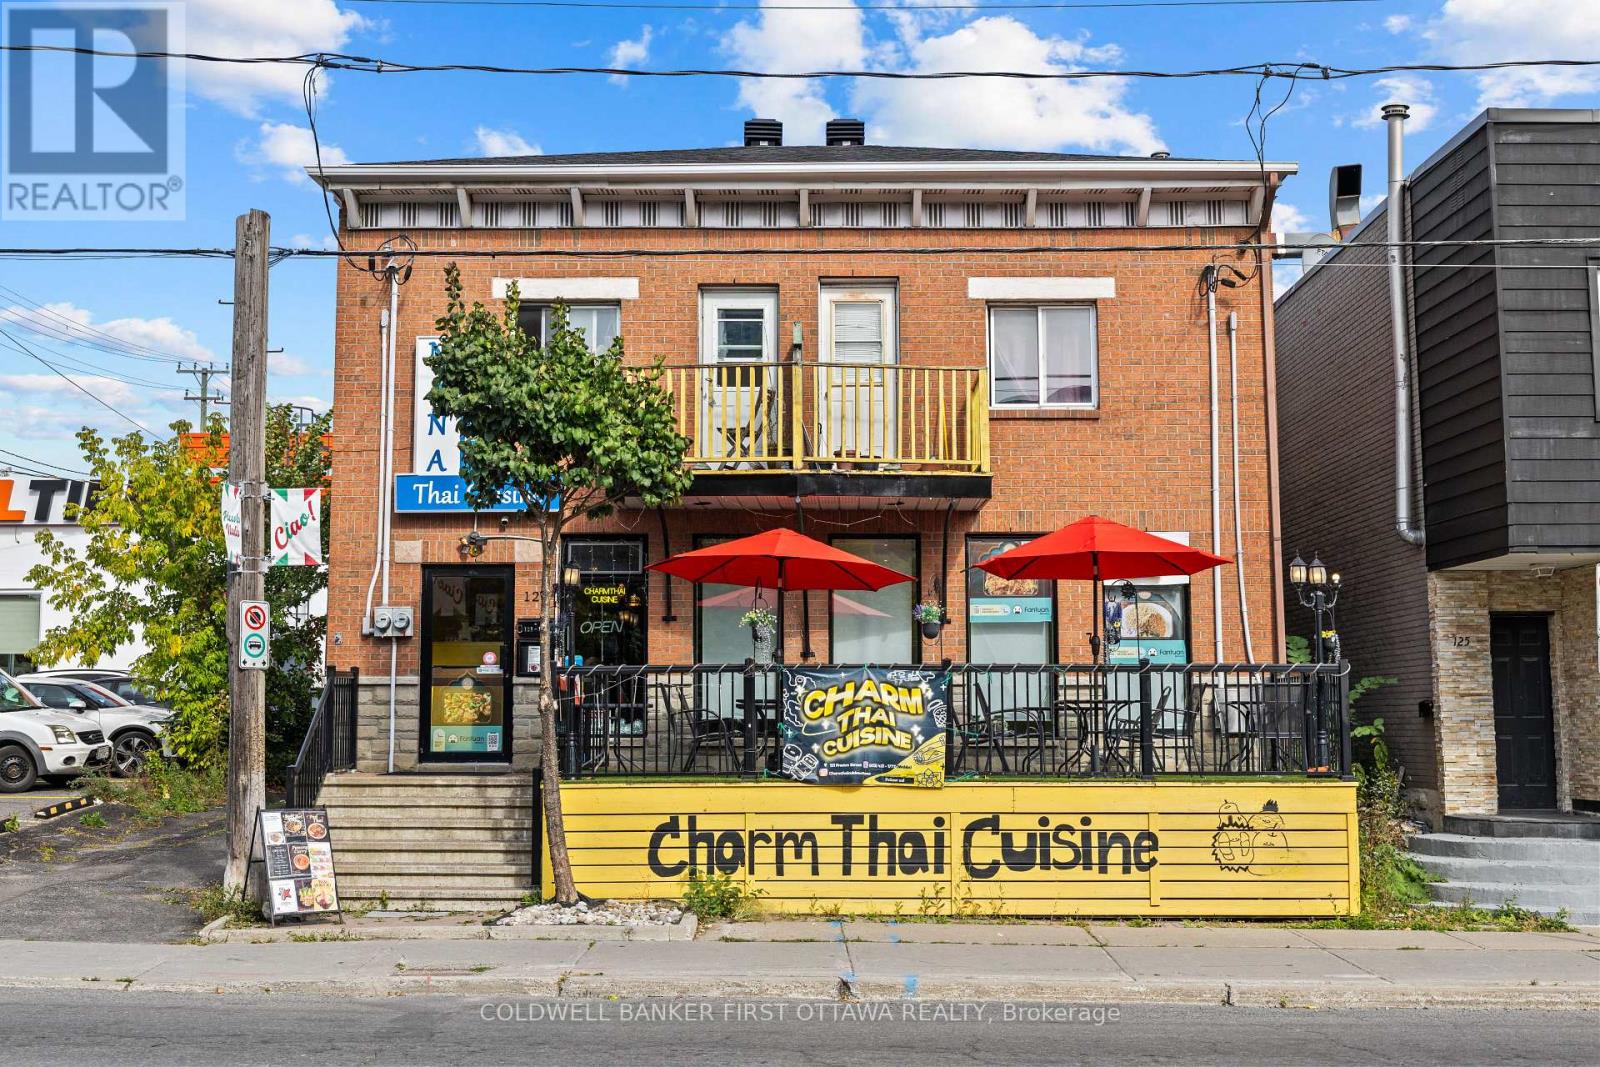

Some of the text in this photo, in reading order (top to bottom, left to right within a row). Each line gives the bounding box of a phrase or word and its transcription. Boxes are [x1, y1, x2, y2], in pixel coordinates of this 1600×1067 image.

[413, 481, 460, 505] Thai
[275, 500, 316, 550] Ciao!
[591, 595, 619, 604] CUISINE
[580, 620, 625, 634] OPEN
[803, 679, 924, 720] CHARM
[837, 706, 897, 733] THAI
[823, 726, 913, 756] CUISINE
[647, 814, 1159, 879] Charm Thai Cuisine
